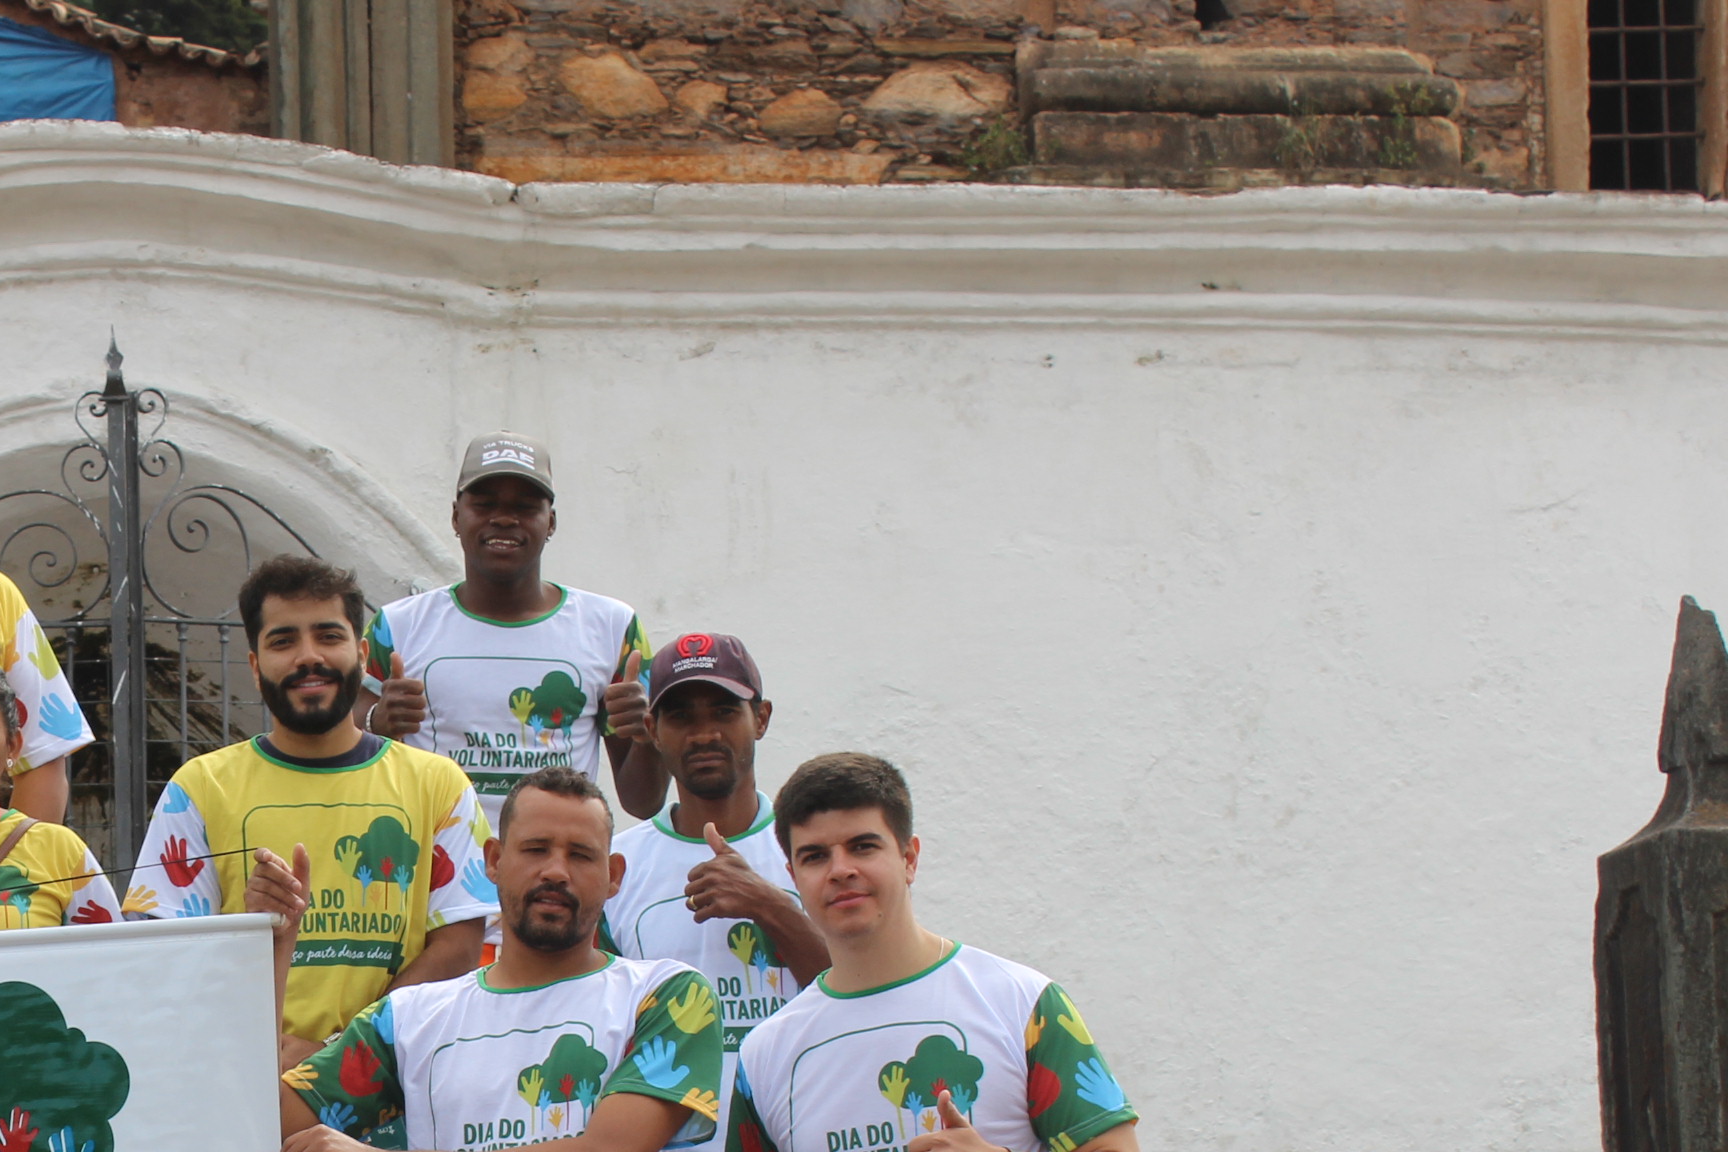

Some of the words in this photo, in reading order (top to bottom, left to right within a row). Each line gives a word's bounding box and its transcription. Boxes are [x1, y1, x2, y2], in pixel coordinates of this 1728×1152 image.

[464, 732, 491, 748] DIA
[496, 733, 516, 748] DO
[482, 779, 510, 793] parte
[321, 888, 345, 909] DO
[306, 946, 337, 962] parte
[338, 944, 365, 959] dessa
[717, 976, 742, 997] DO
[464, 1122, 494, 1145] DIA
[499, 1118, 525, 1140] DO
[827, 1127, 862, 1152] DIA
[866, 1121, 894, 1146] DO
